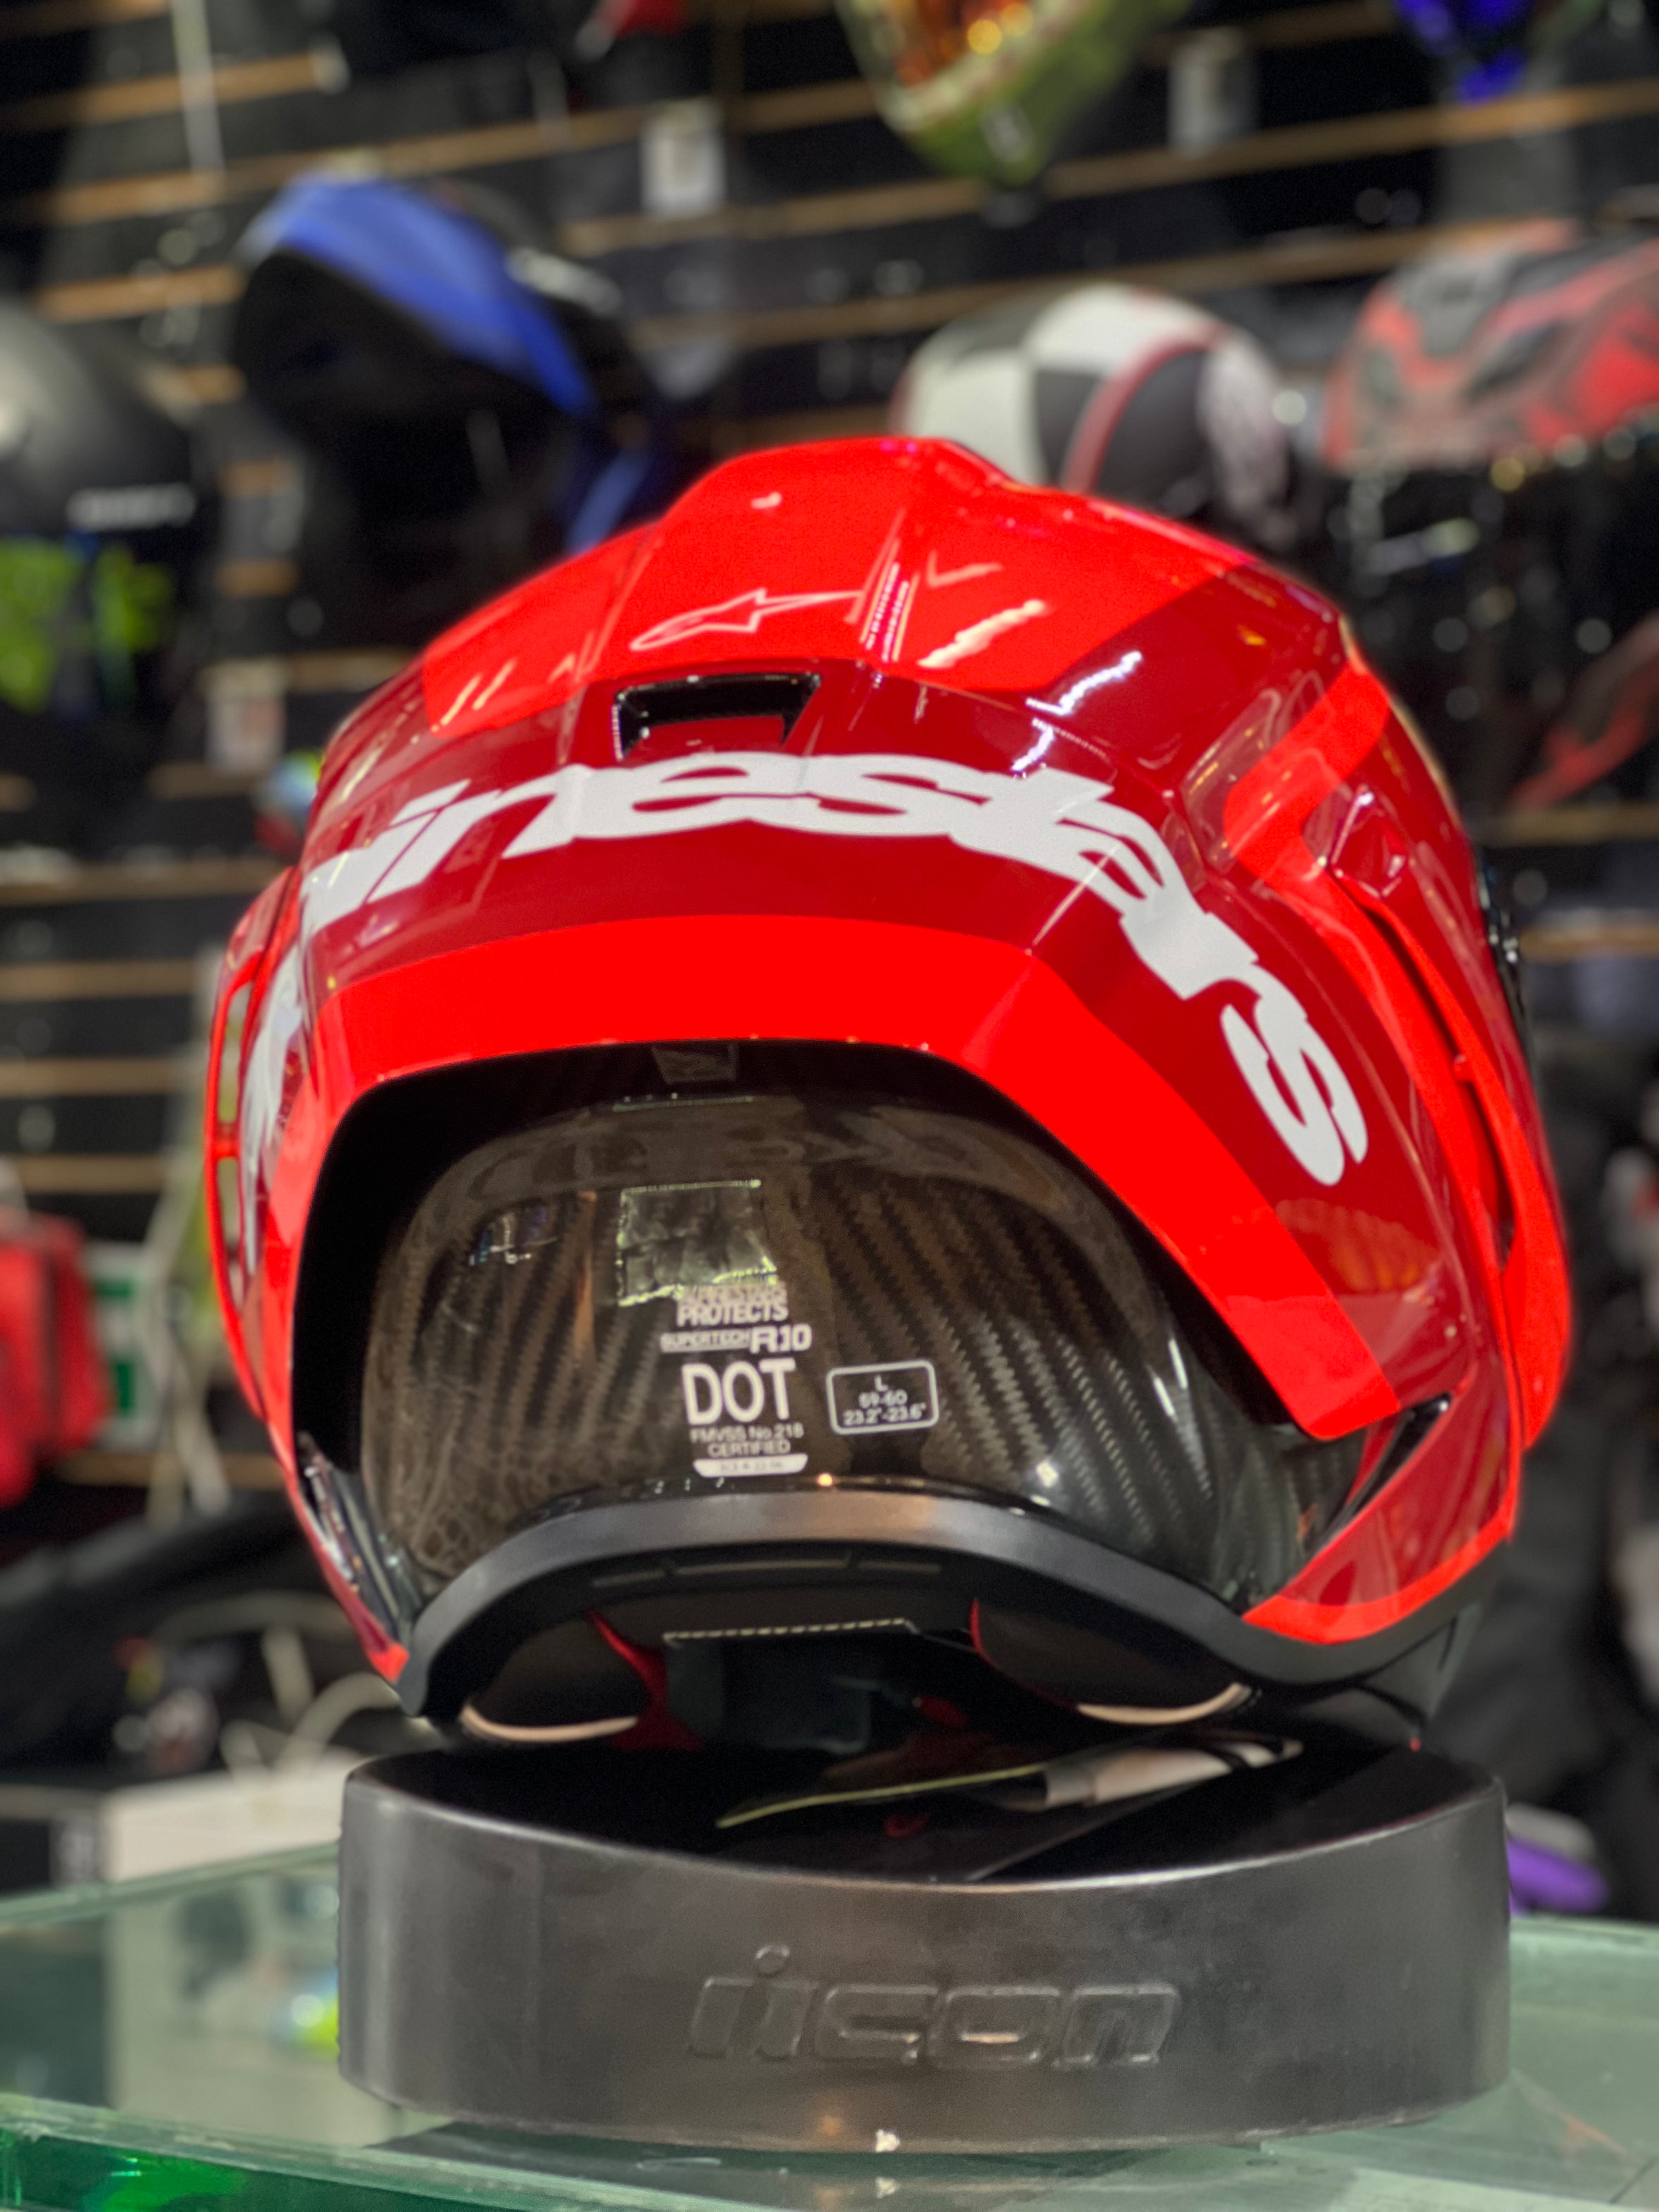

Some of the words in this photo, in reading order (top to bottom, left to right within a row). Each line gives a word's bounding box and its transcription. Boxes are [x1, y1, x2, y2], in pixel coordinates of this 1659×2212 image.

[677, 1302, 789, 1327] PROTECTS
[682, 1357, 796, 1425] DOT
[874, 1374, 889, 1392] L
